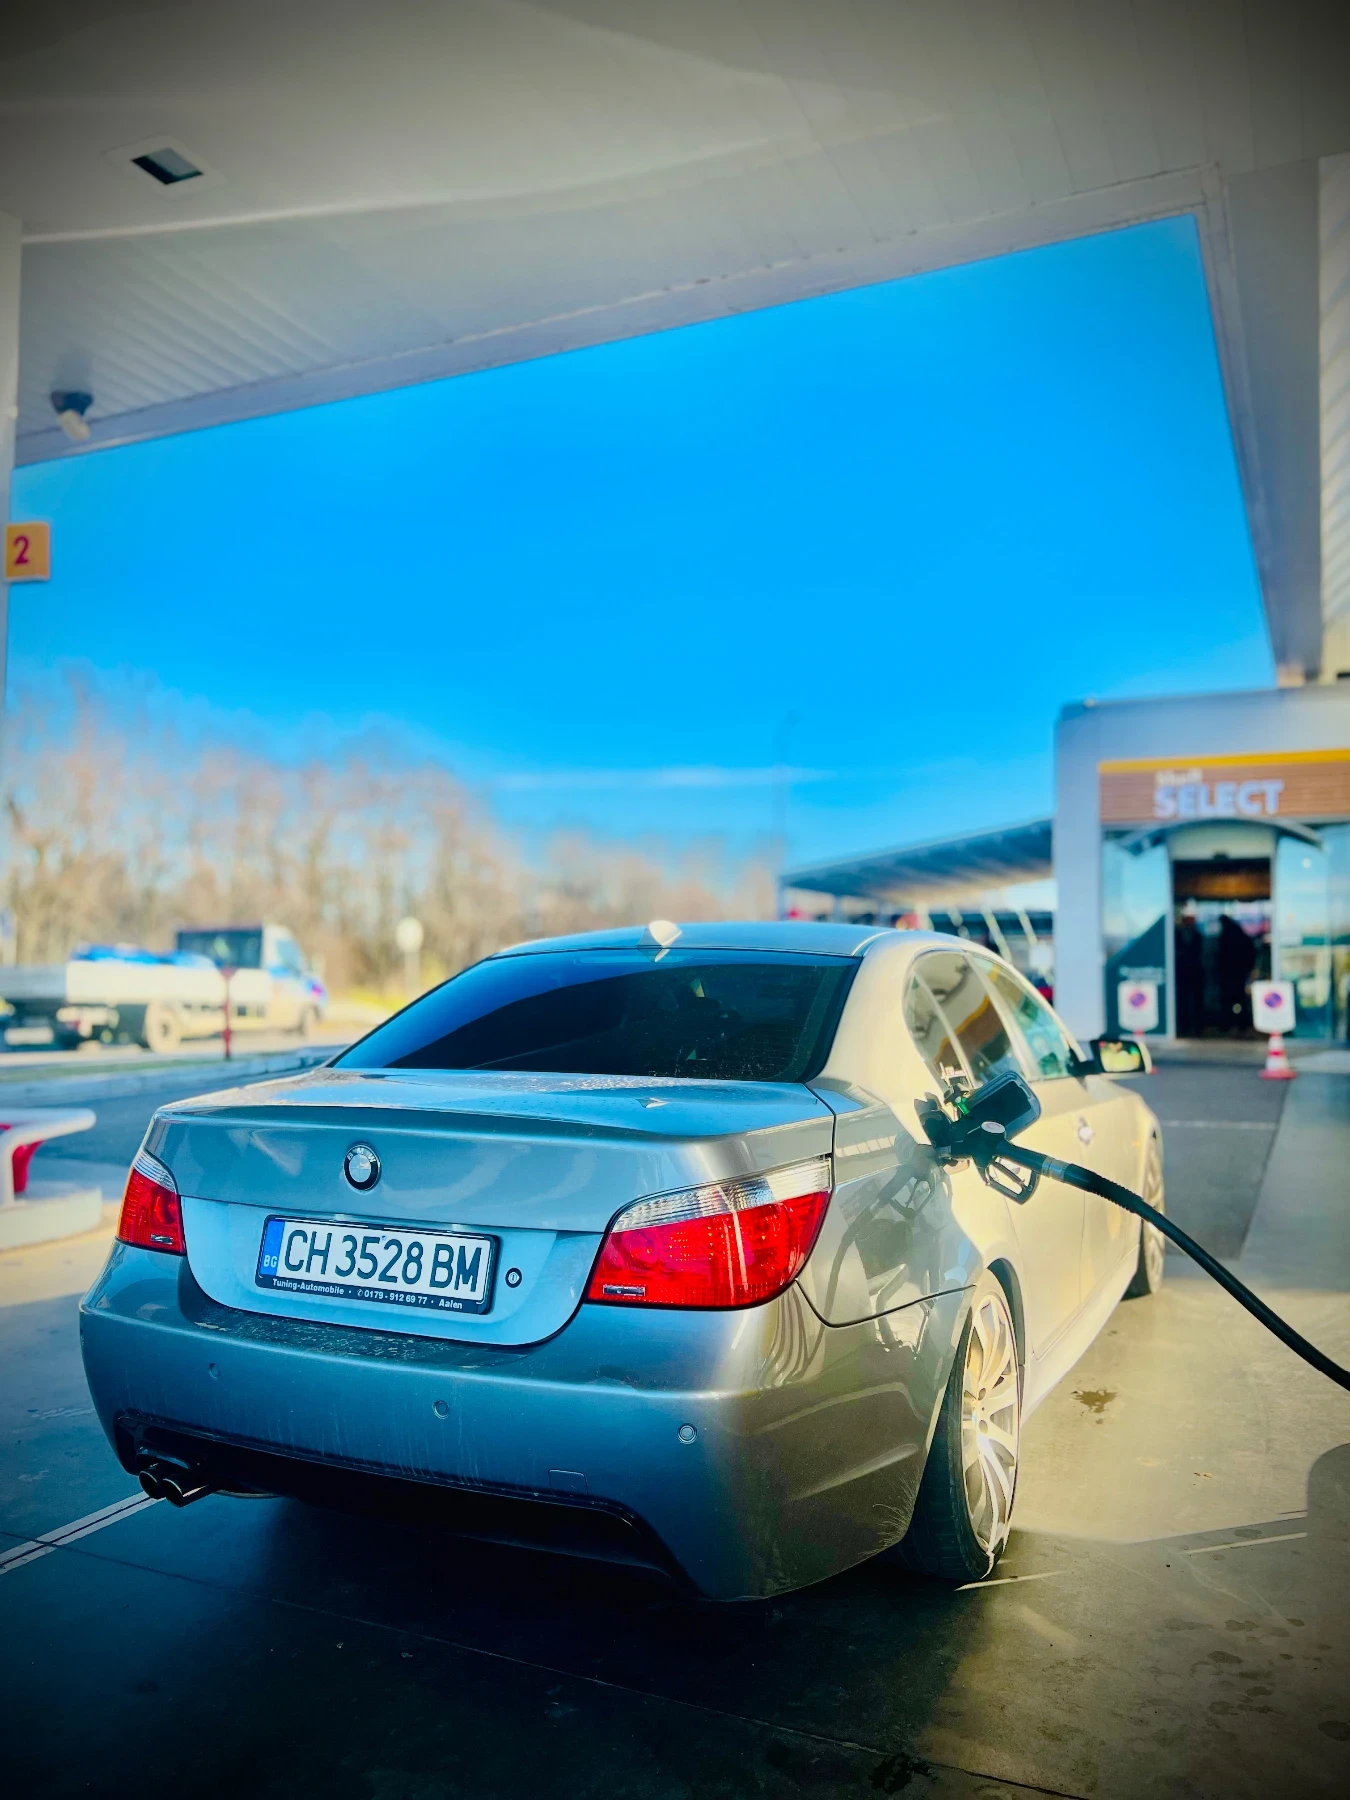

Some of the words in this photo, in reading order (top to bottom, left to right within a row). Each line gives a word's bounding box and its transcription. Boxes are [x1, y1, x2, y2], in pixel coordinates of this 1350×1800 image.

[12, 535, 29, 565] 2
[1153, 779, 1285, 819] SELECT
[346, 1147, 377, 1163] BMW
[263, 1254, 278, 1268] BG
[335, 1234, 424, 1285] 3528
[272, 1278, 345, 1295] Tuning-Automobile
[405, 1294, 416, 1304] 69
[417, 1296, 428, 1305] 77
[438, 1298, 463, 1310] Aalen
